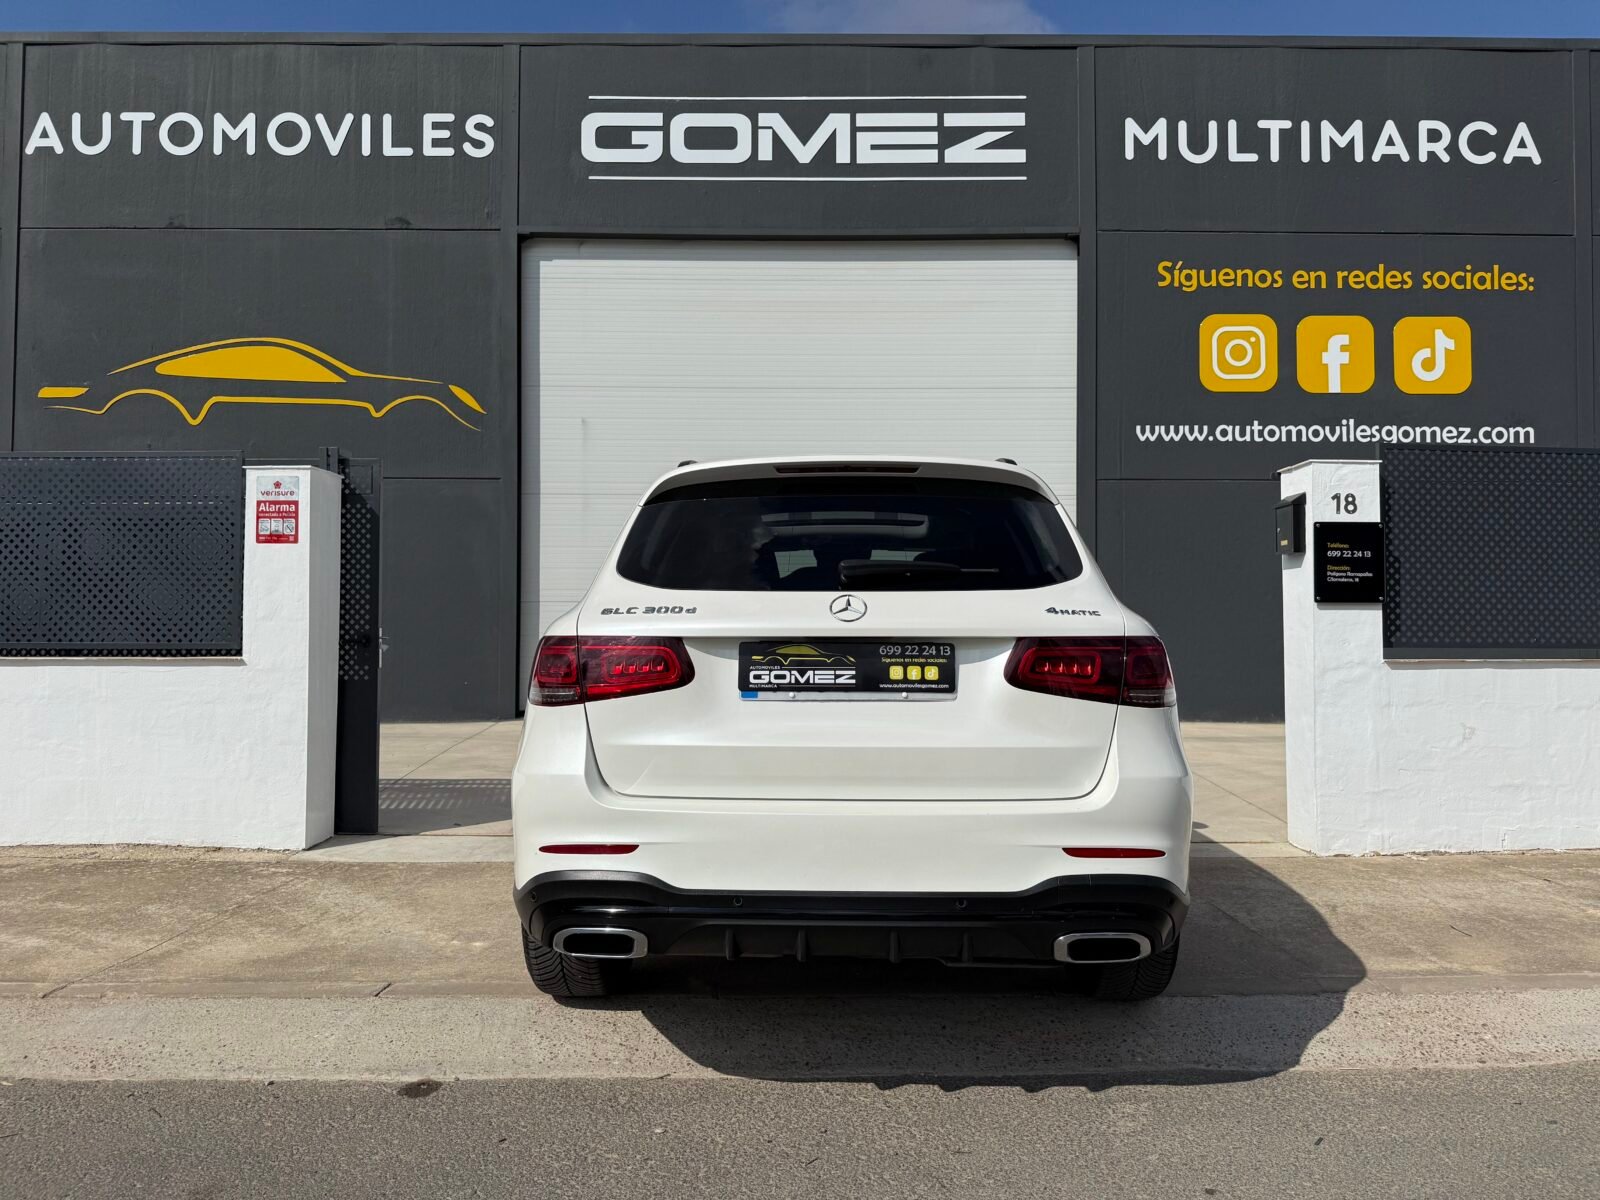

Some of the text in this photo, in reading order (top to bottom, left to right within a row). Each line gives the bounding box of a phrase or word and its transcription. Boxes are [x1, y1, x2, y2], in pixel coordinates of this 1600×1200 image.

[24, 111, 495, 158] AUTOMOVILES
[580, 112, 1027, 164] GOMEZ
[1124, 117, 1542, 166] MULTIMARCA
[1157, 260, 1535, 293] Síguenos en redes sociales:
[1135, 418, 1535, 444] www.automovilesgomez.com
[258, 502, 296, 512] Alarma
[1330, 492, 1358, 515] 18
[1327, 550, 1372, 558] 699 22 24 13
[600, 606, 640, 616] GLC
[879, 645, 951, 656] 699 22 24 13
[749, 670, 856, 684] GOMEZ
